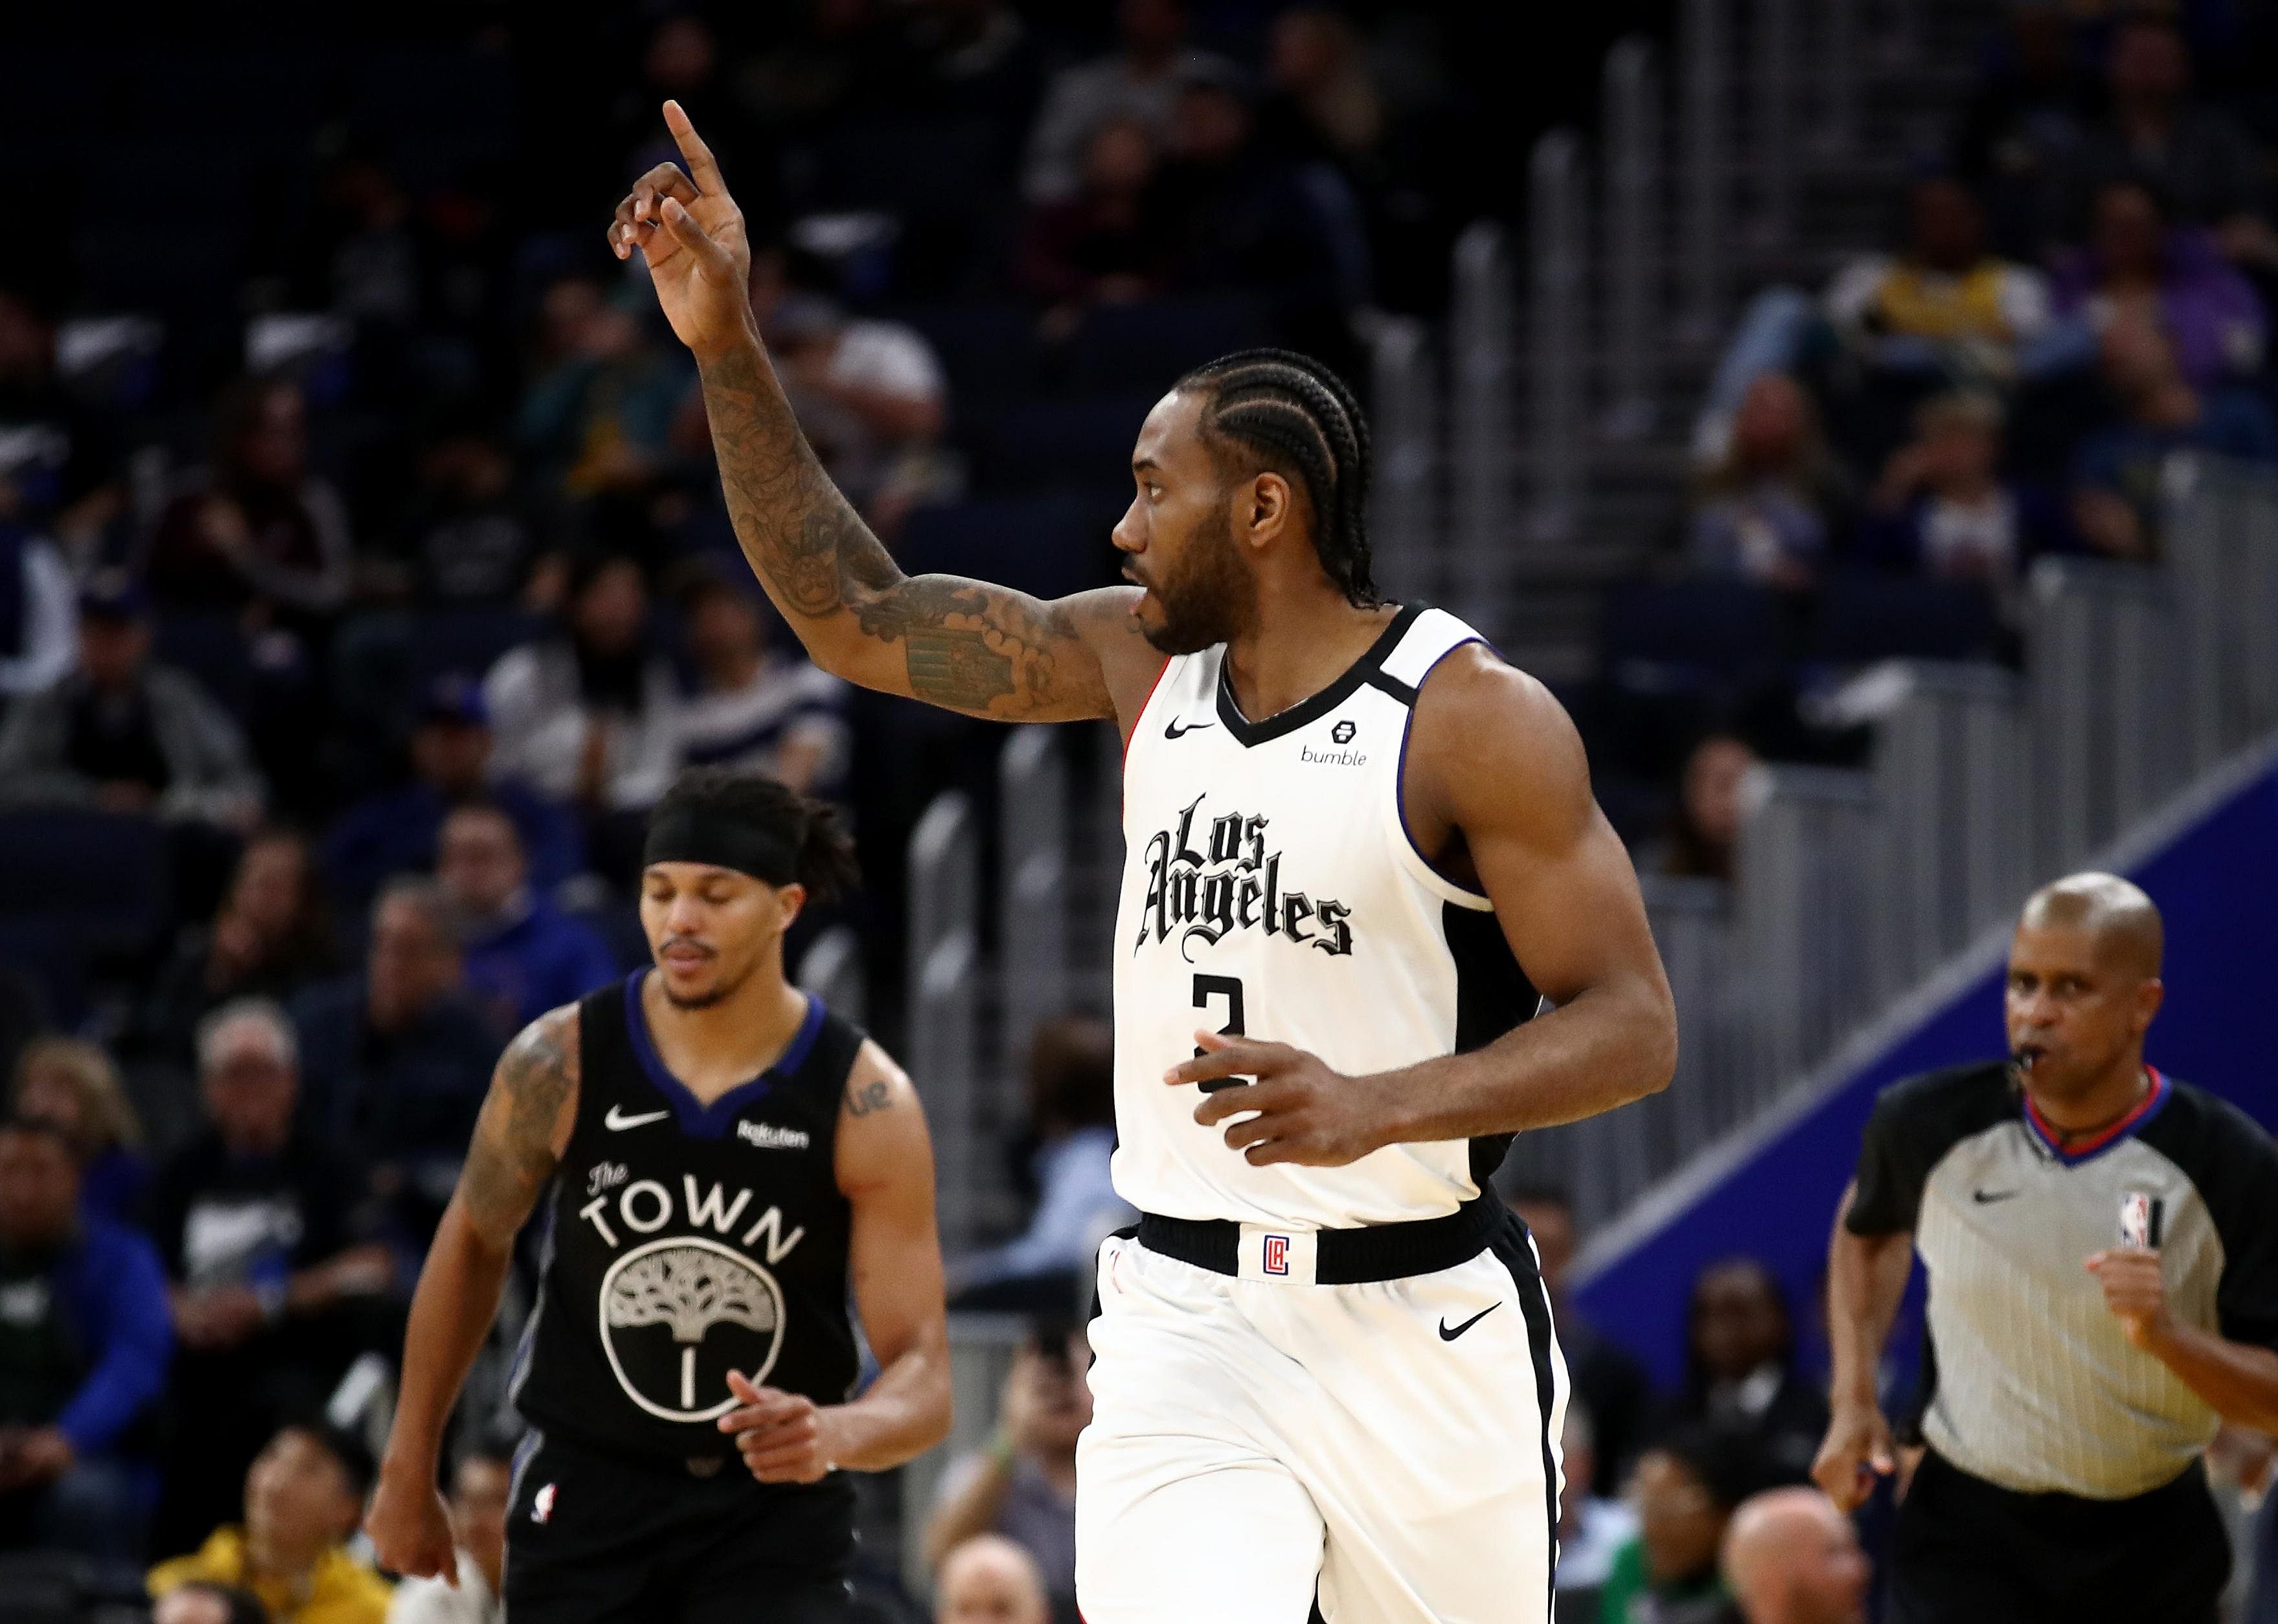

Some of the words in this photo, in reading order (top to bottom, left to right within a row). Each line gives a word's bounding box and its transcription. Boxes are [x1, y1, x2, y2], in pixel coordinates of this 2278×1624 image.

[1301, 745, 1367, 765] bumble
[1169, 792, 1269, 872] Los
[1134, 830, 1352, 963] Angeles
[580, 1173, 806, 1264] TOWN
[587, 1161, 628, 1196] The
